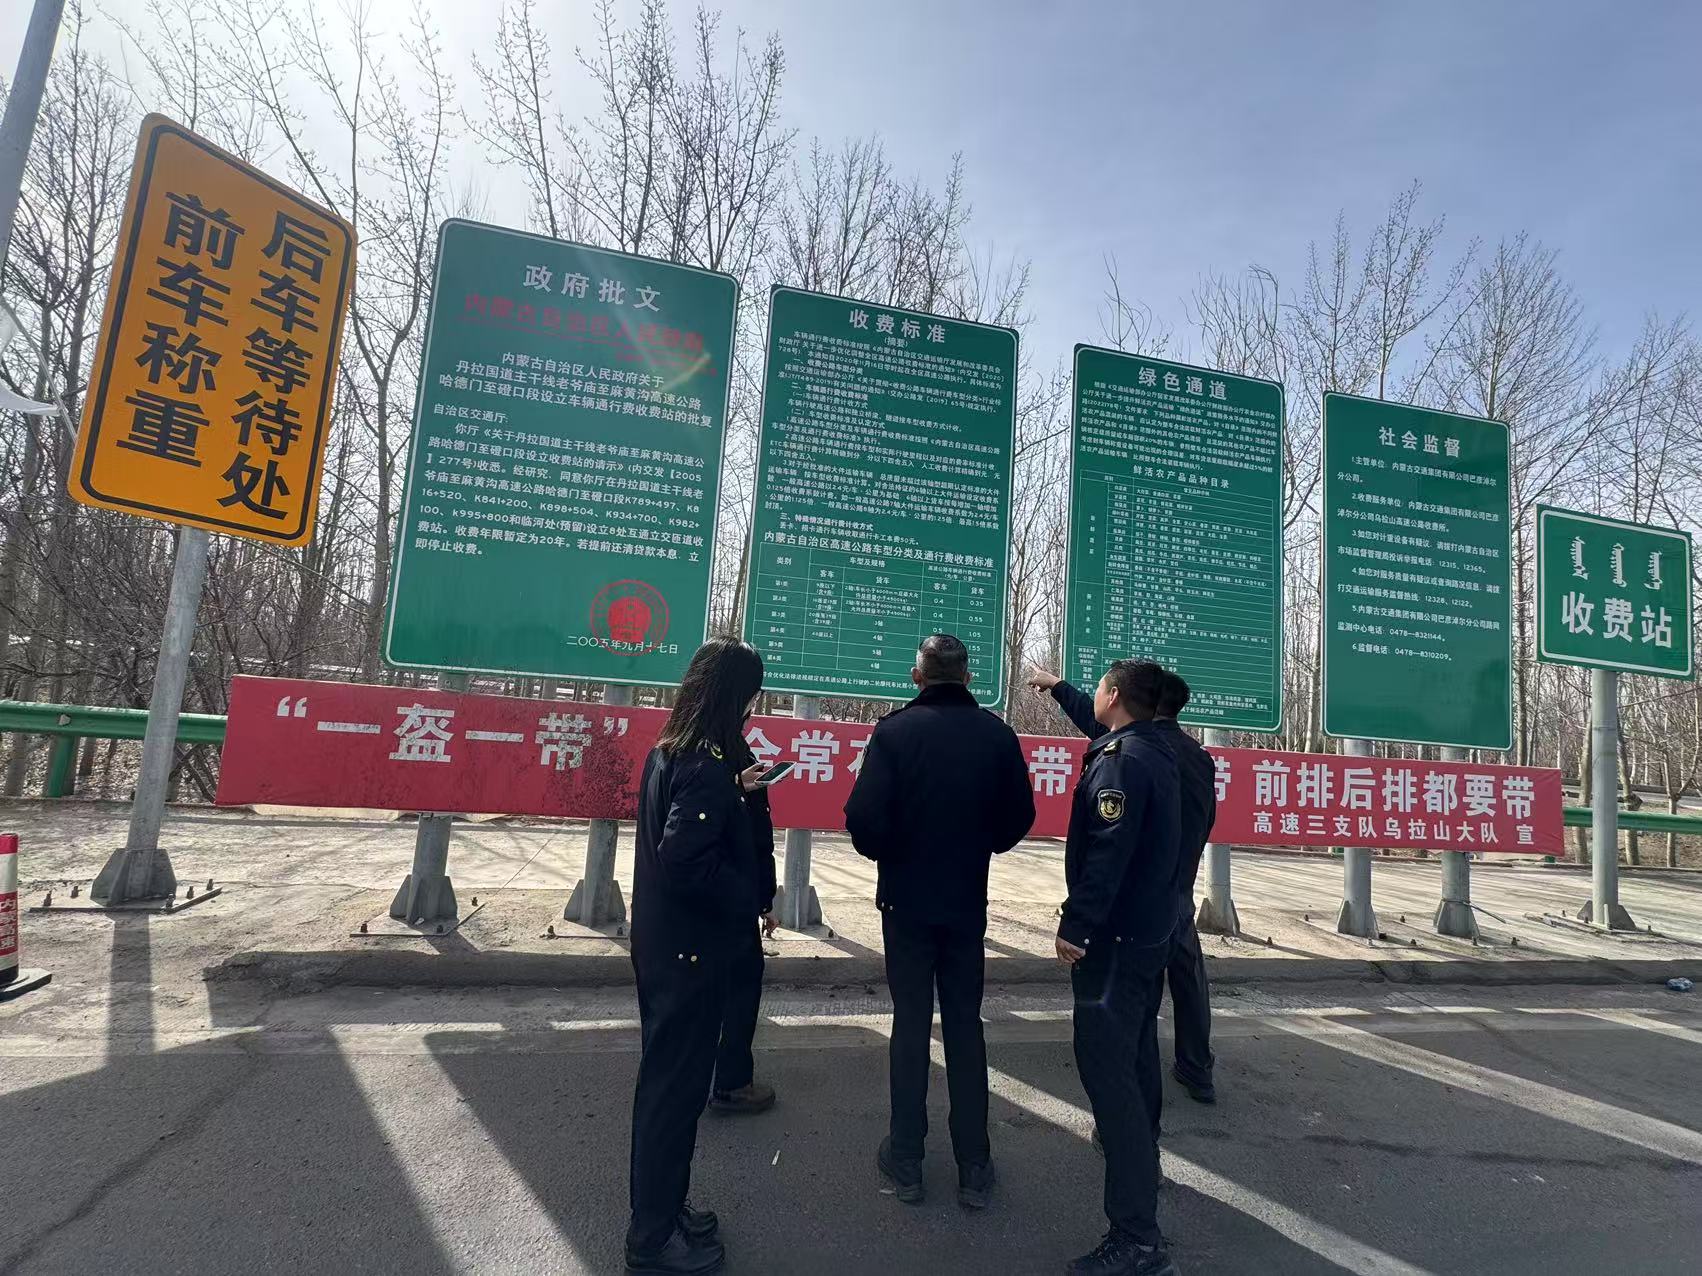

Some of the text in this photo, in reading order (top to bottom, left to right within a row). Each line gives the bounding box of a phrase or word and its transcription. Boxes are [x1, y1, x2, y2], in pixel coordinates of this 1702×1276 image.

[524, 265, 660, 311] 政府批文
[116, 191, 246, 468] 前车称重
[849, 309, 945, 343] 收费标准
[217, 210, 331, 521] 后车等待处
[457, 360, 701, 410] 丹拉国道主干线老爷庙至麻黄沟高速公路
[502, 353, 665, 392] 内蒙古自治区人民政府关于
[1138, 367, 1226, 400] 绿色通道
[439, 374, 711, 427] 哈德门至磴口段设立车辆通行费收费站的批复
[1379, 426, 1460, 458] 社会监督
[1133, 465, 1229, 489] 鲜活农产品品种目录
[764, 531, 993, 568] 内蒙古自治区高速公路车型分类及通行费收费标准
[776, 556, 792, 566] 类别
[1561, 591, 1672, 648] 收费站
[1028, 745, 1073, 797] 带
[1252, 758, 1536, 820] 前排后排都要带
[1253, 811, 1535, 846] 高速三支队乌拉山大队 宣
